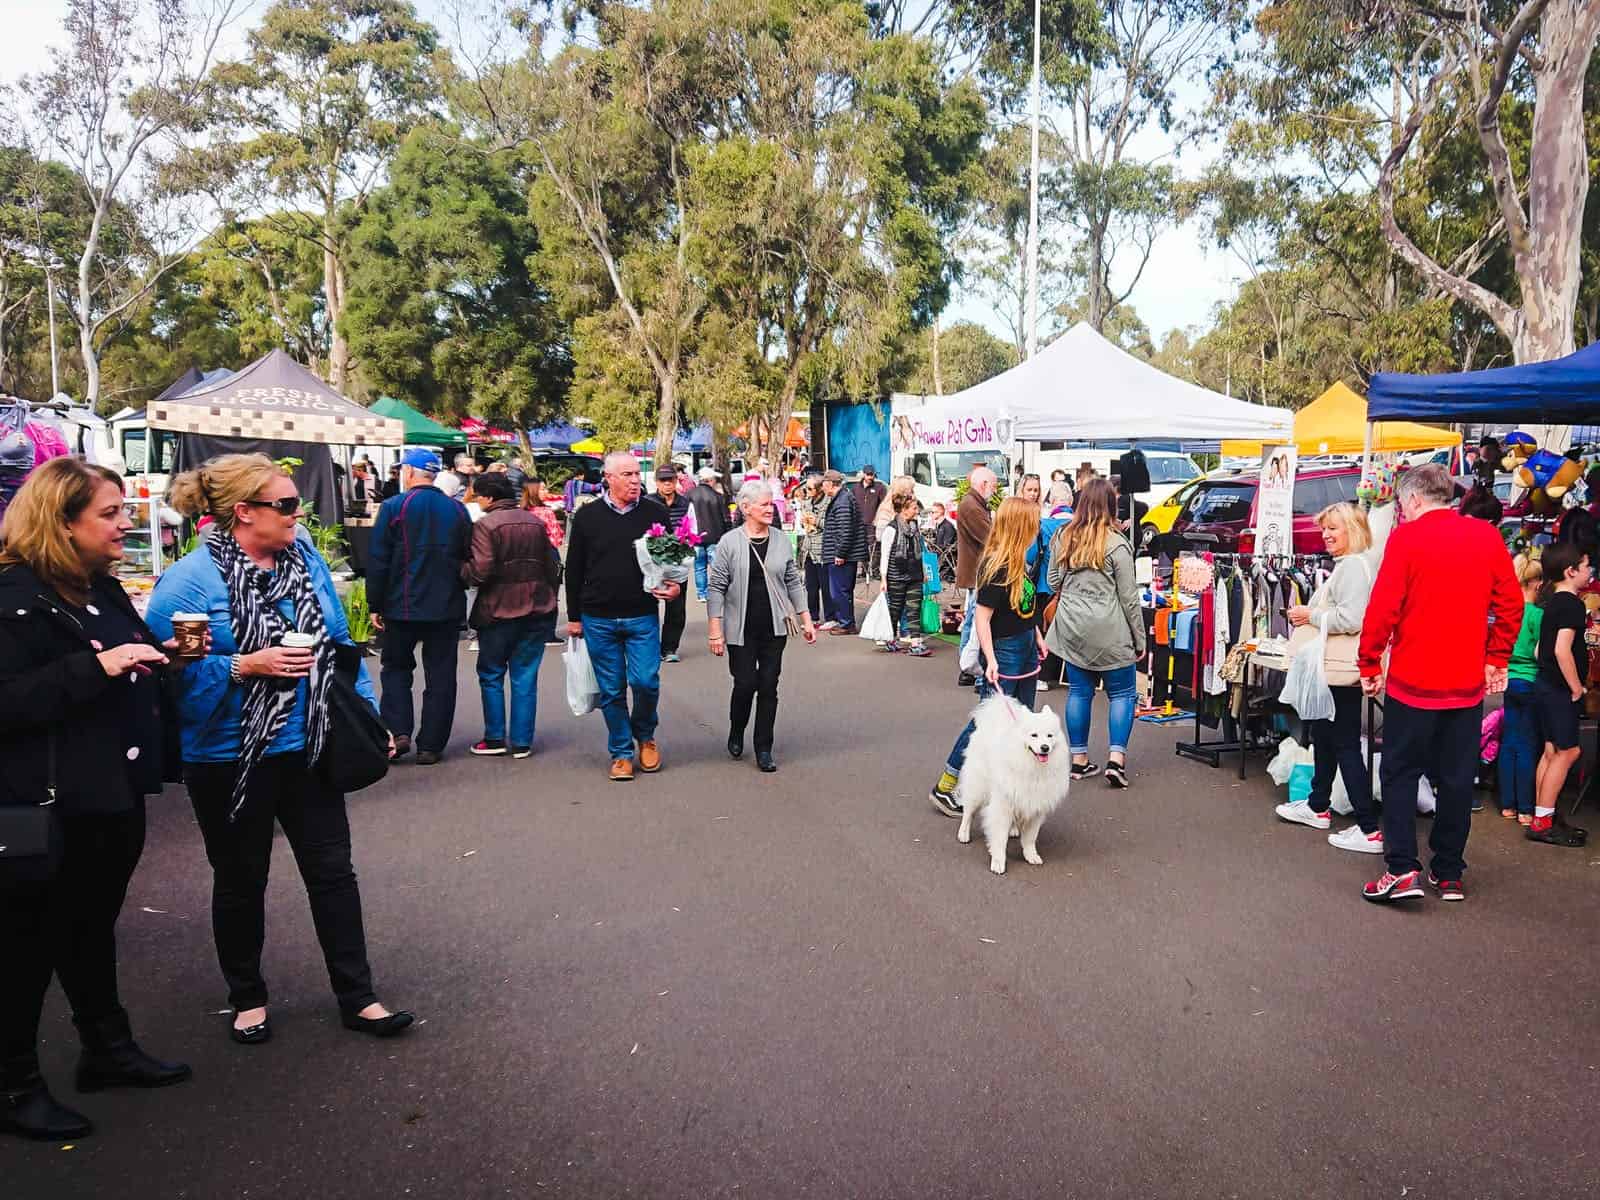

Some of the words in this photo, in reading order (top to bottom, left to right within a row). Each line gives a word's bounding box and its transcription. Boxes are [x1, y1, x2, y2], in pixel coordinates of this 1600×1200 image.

[236, 387, 321, 402] FRESH
[212, 396, 346, 412] LICORICE
[914, 421, 945, 445] Flower
[947, 419, 963, 444] Pot
[965, 416, 992, 442] Girls
